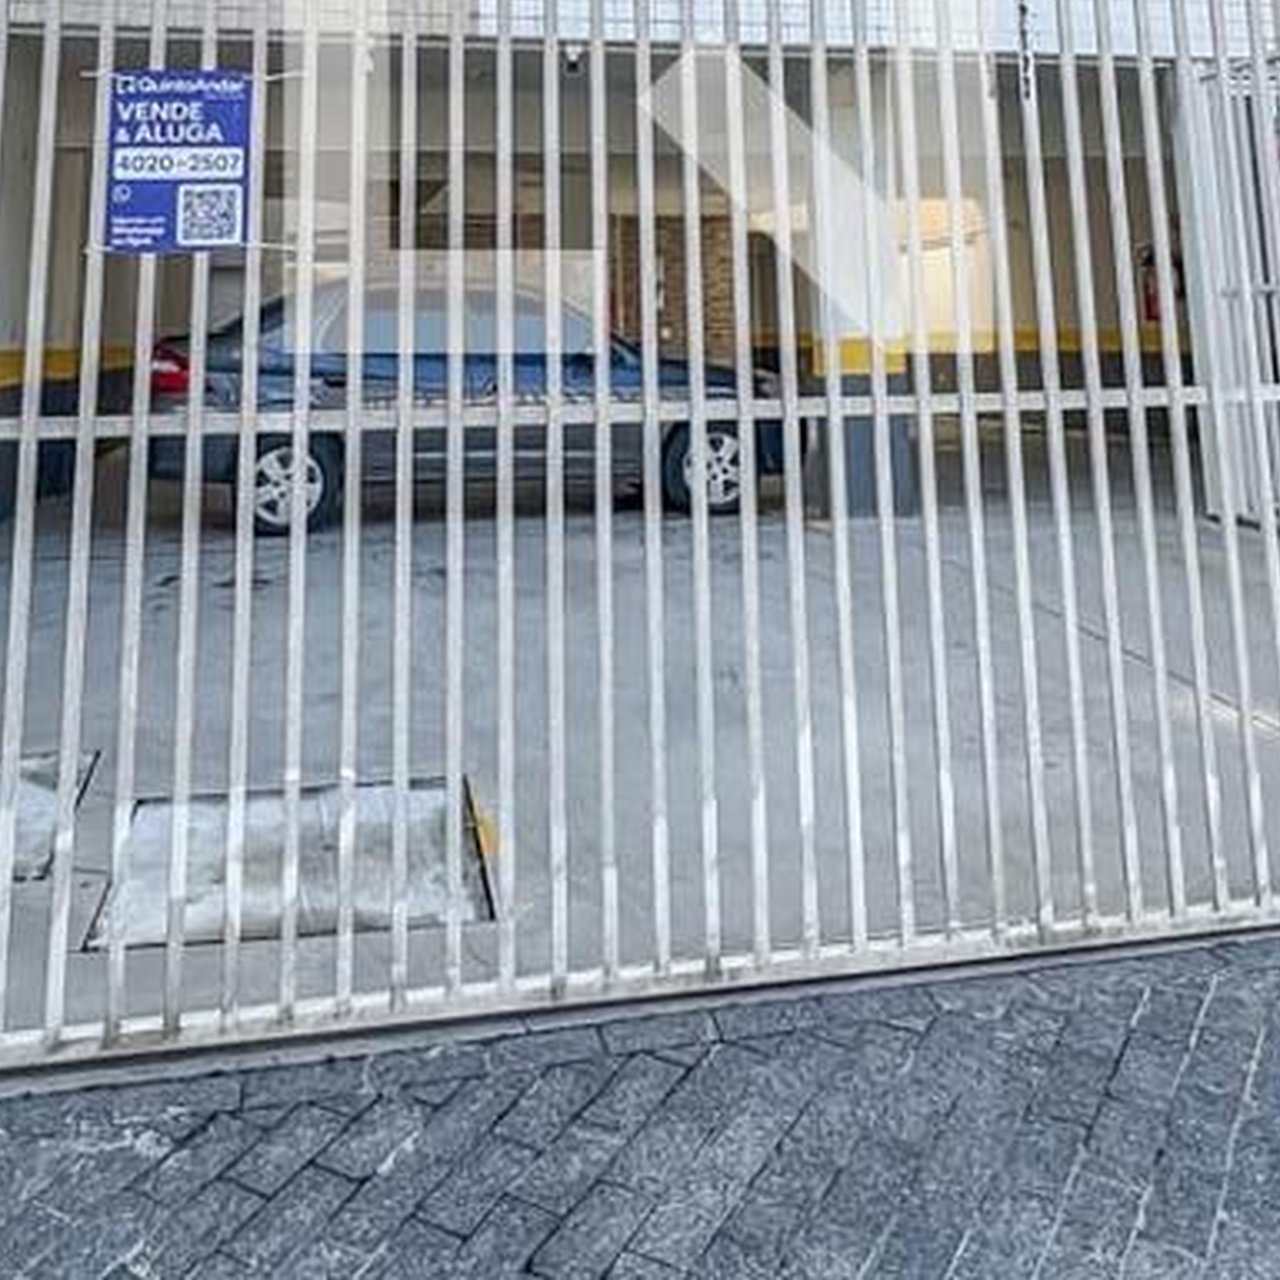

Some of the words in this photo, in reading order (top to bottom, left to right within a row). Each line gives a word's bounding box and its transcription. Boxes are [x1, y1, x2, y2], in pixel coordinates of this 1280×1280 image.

[117, 102, 204, 122] VENDE
[134, 123, 224, 144] ALUGA
[117, 153, 241, 173] 4020-2507
